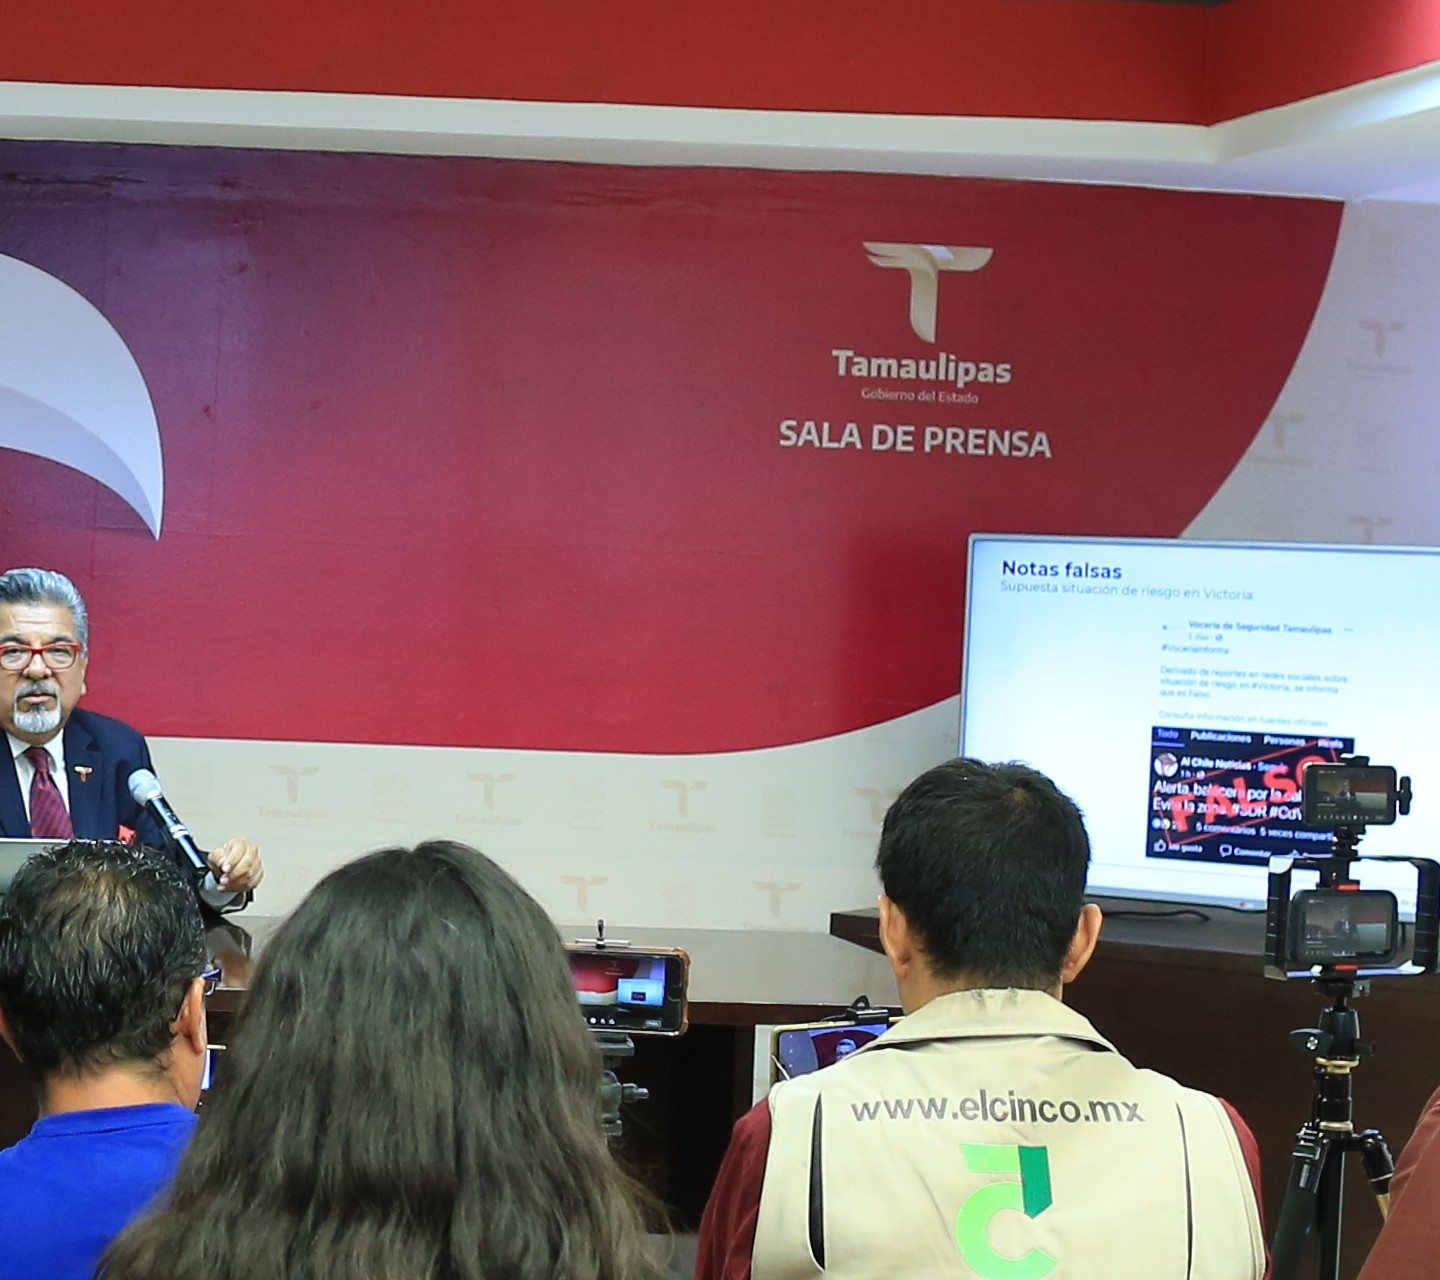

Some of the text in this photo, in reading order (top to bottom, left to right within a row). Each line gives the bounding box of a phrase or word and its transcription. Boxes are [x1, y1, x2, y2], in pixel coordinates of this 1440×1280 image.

[831, 348, 1012, 388] Tamaulipas
[861, 387, 979, 405] Gobierno del Estado
[778, 419, 1052, 458] SALA DE PRENSA
[1001, 560, 1123, 580] Notas falsas
[1000, 580, 1254, 601] Supuesta situación de riesgo en Victoria
[1222, 621, 1234, 630] de
[1236, 622, 1280, 633] Seguridad
[1283, 623, 1332, 635] Tamaulipas
[1160, 665, 1349, 684] Derivado de reportes en redes sociales sobre
[1159, 689, 1175, 699] que
[1176, 690, 1187, 698] es
[1199, 678, 1210, 687] de
[1211, 679, 1238, 691] riesgo
[1239, 681, 1250, 689] en
[1294, 684, 1305, 692] se
[1306, 683, 1339, 695] informa
[1157, 728, 1180, 740] Todo
[1190, 730, 1252, 744] Publicaciones
[1263, 734, 1306, 747] Personas
[1191, 757, 1214, 768] Chile
[1215, 758, 1252, 771] Noticias
[1193, 782, 1247, 799] balcera
[1247, 787, 1268, 803] por
[1203, 824, 1256, 836] comentarios
[1294, 830, 1334, 842] comparti
[850, 1088, 1146, 1123] www.elcinco.mx
